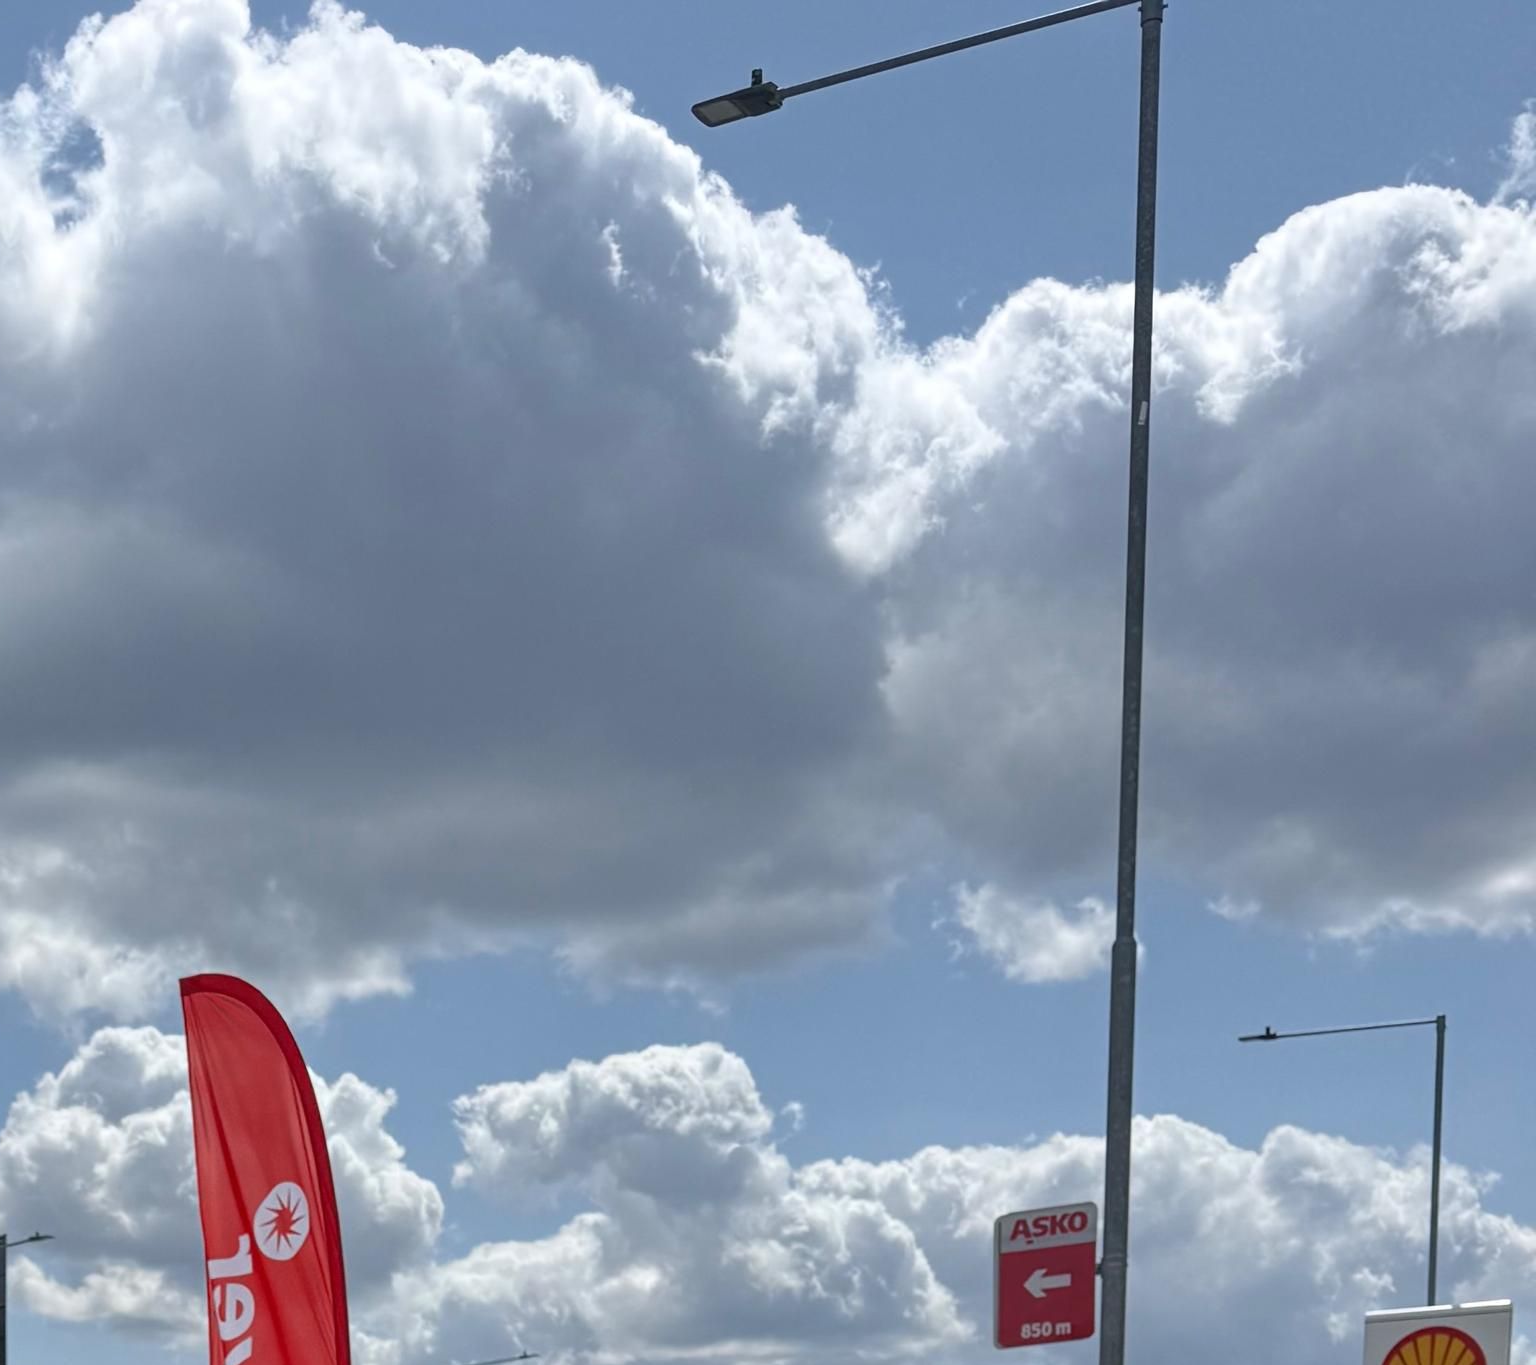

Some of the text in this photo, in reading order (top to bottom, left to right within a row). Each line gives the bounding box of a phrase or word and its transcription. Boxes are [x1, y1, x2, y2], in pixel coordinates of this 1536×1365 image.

[1010, 1211, 1088, 1243] ASKO
[1020, 1322, 1072, 1339] 850 m
